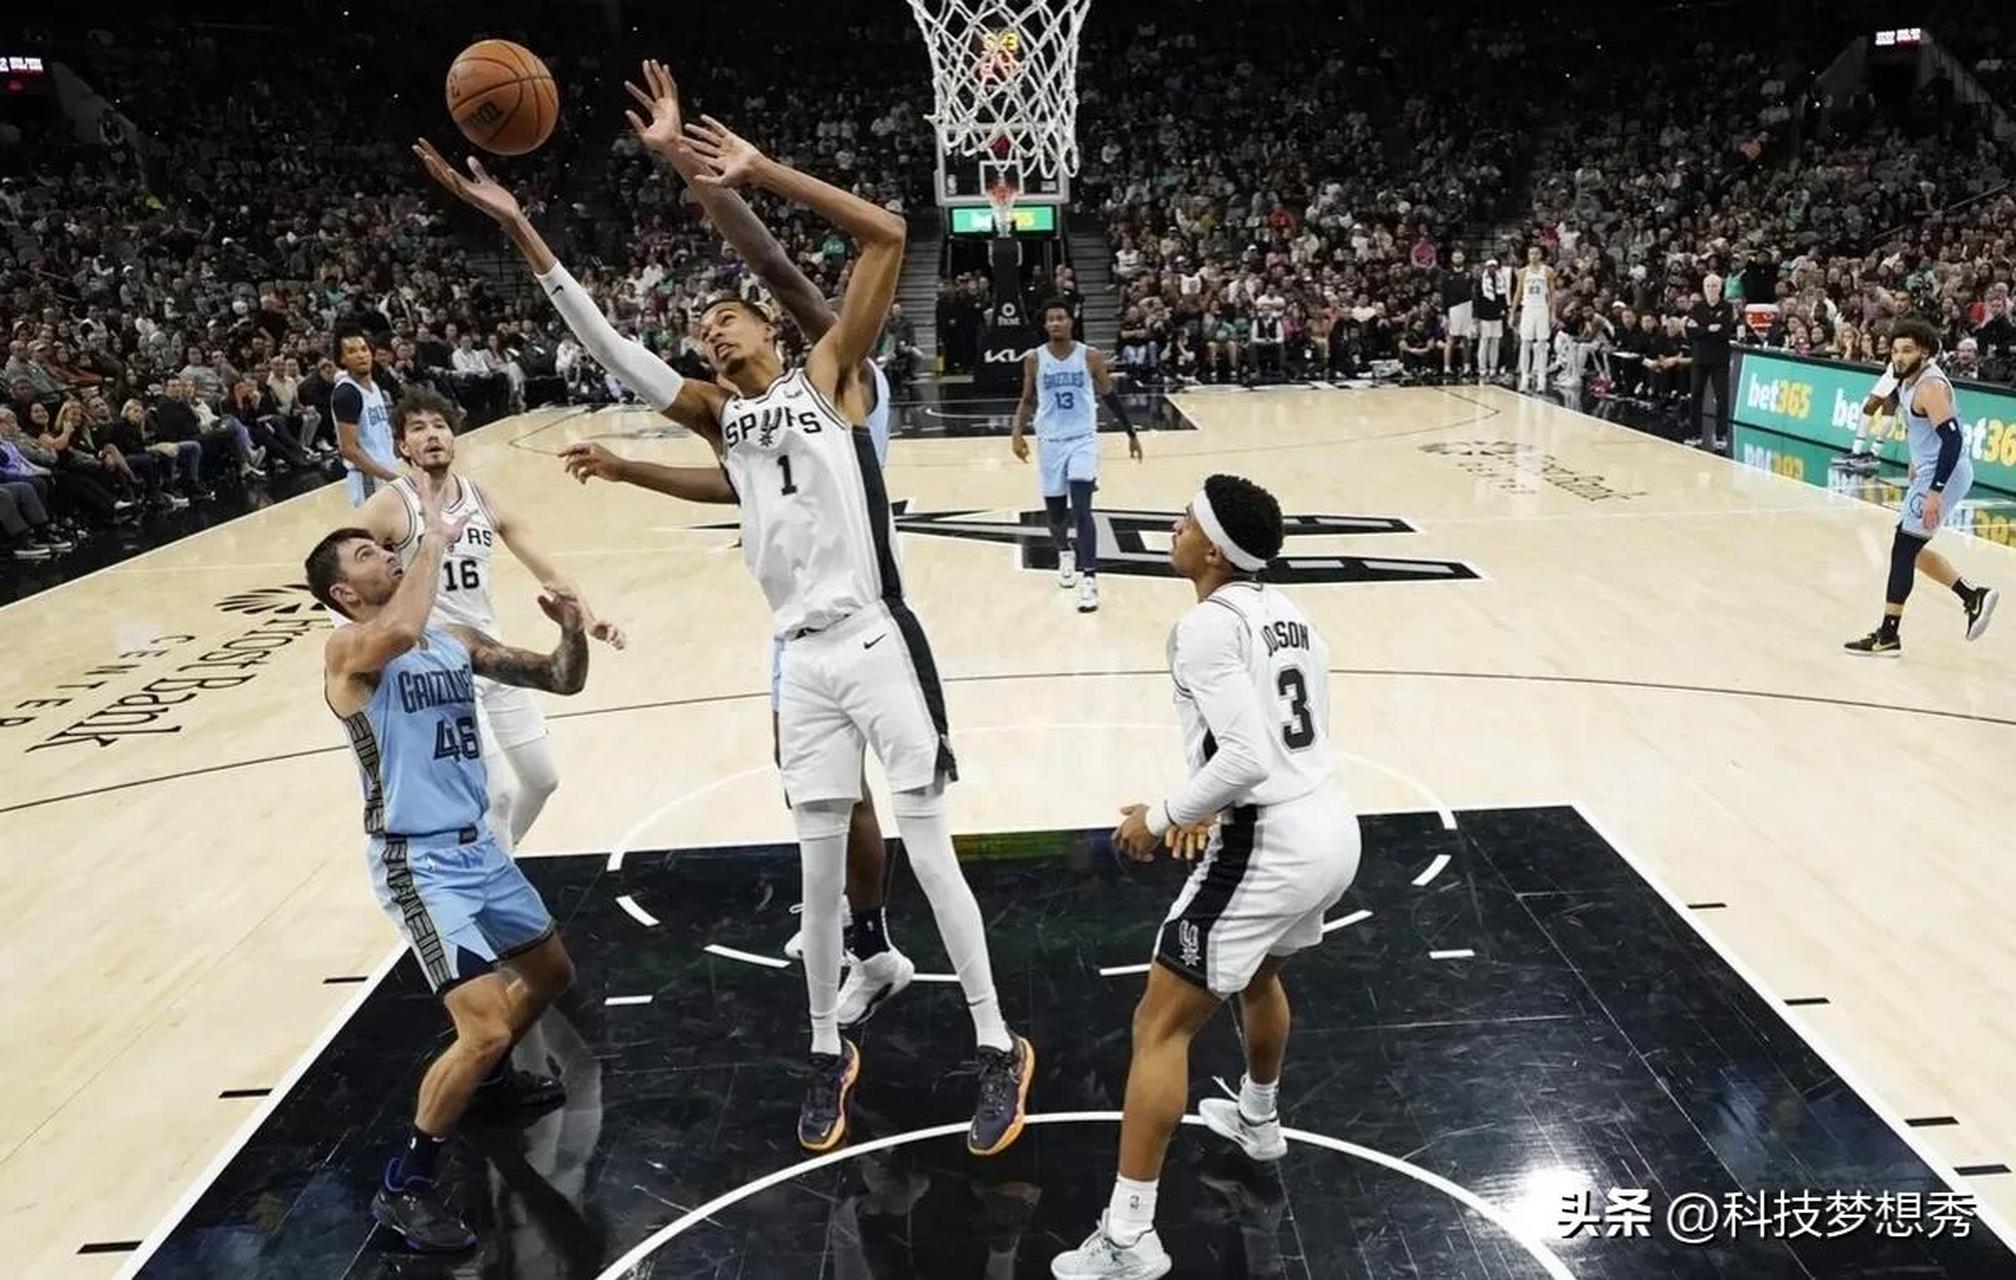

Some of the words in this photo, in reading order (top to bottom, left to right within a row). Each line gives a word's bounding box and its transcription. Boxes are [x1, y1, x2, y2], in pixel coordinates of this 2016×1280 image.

[1054, 391, 1075, 410] 13
[1747, 373, 1815, 420] bet365
[777, 454, 798, 496] 1
[442, 559, 480, 592] 16
[24, 673, 257, 753] Bank
[1277, 667, 1315, 750] 3
[433, 716, 480, 762] 46
